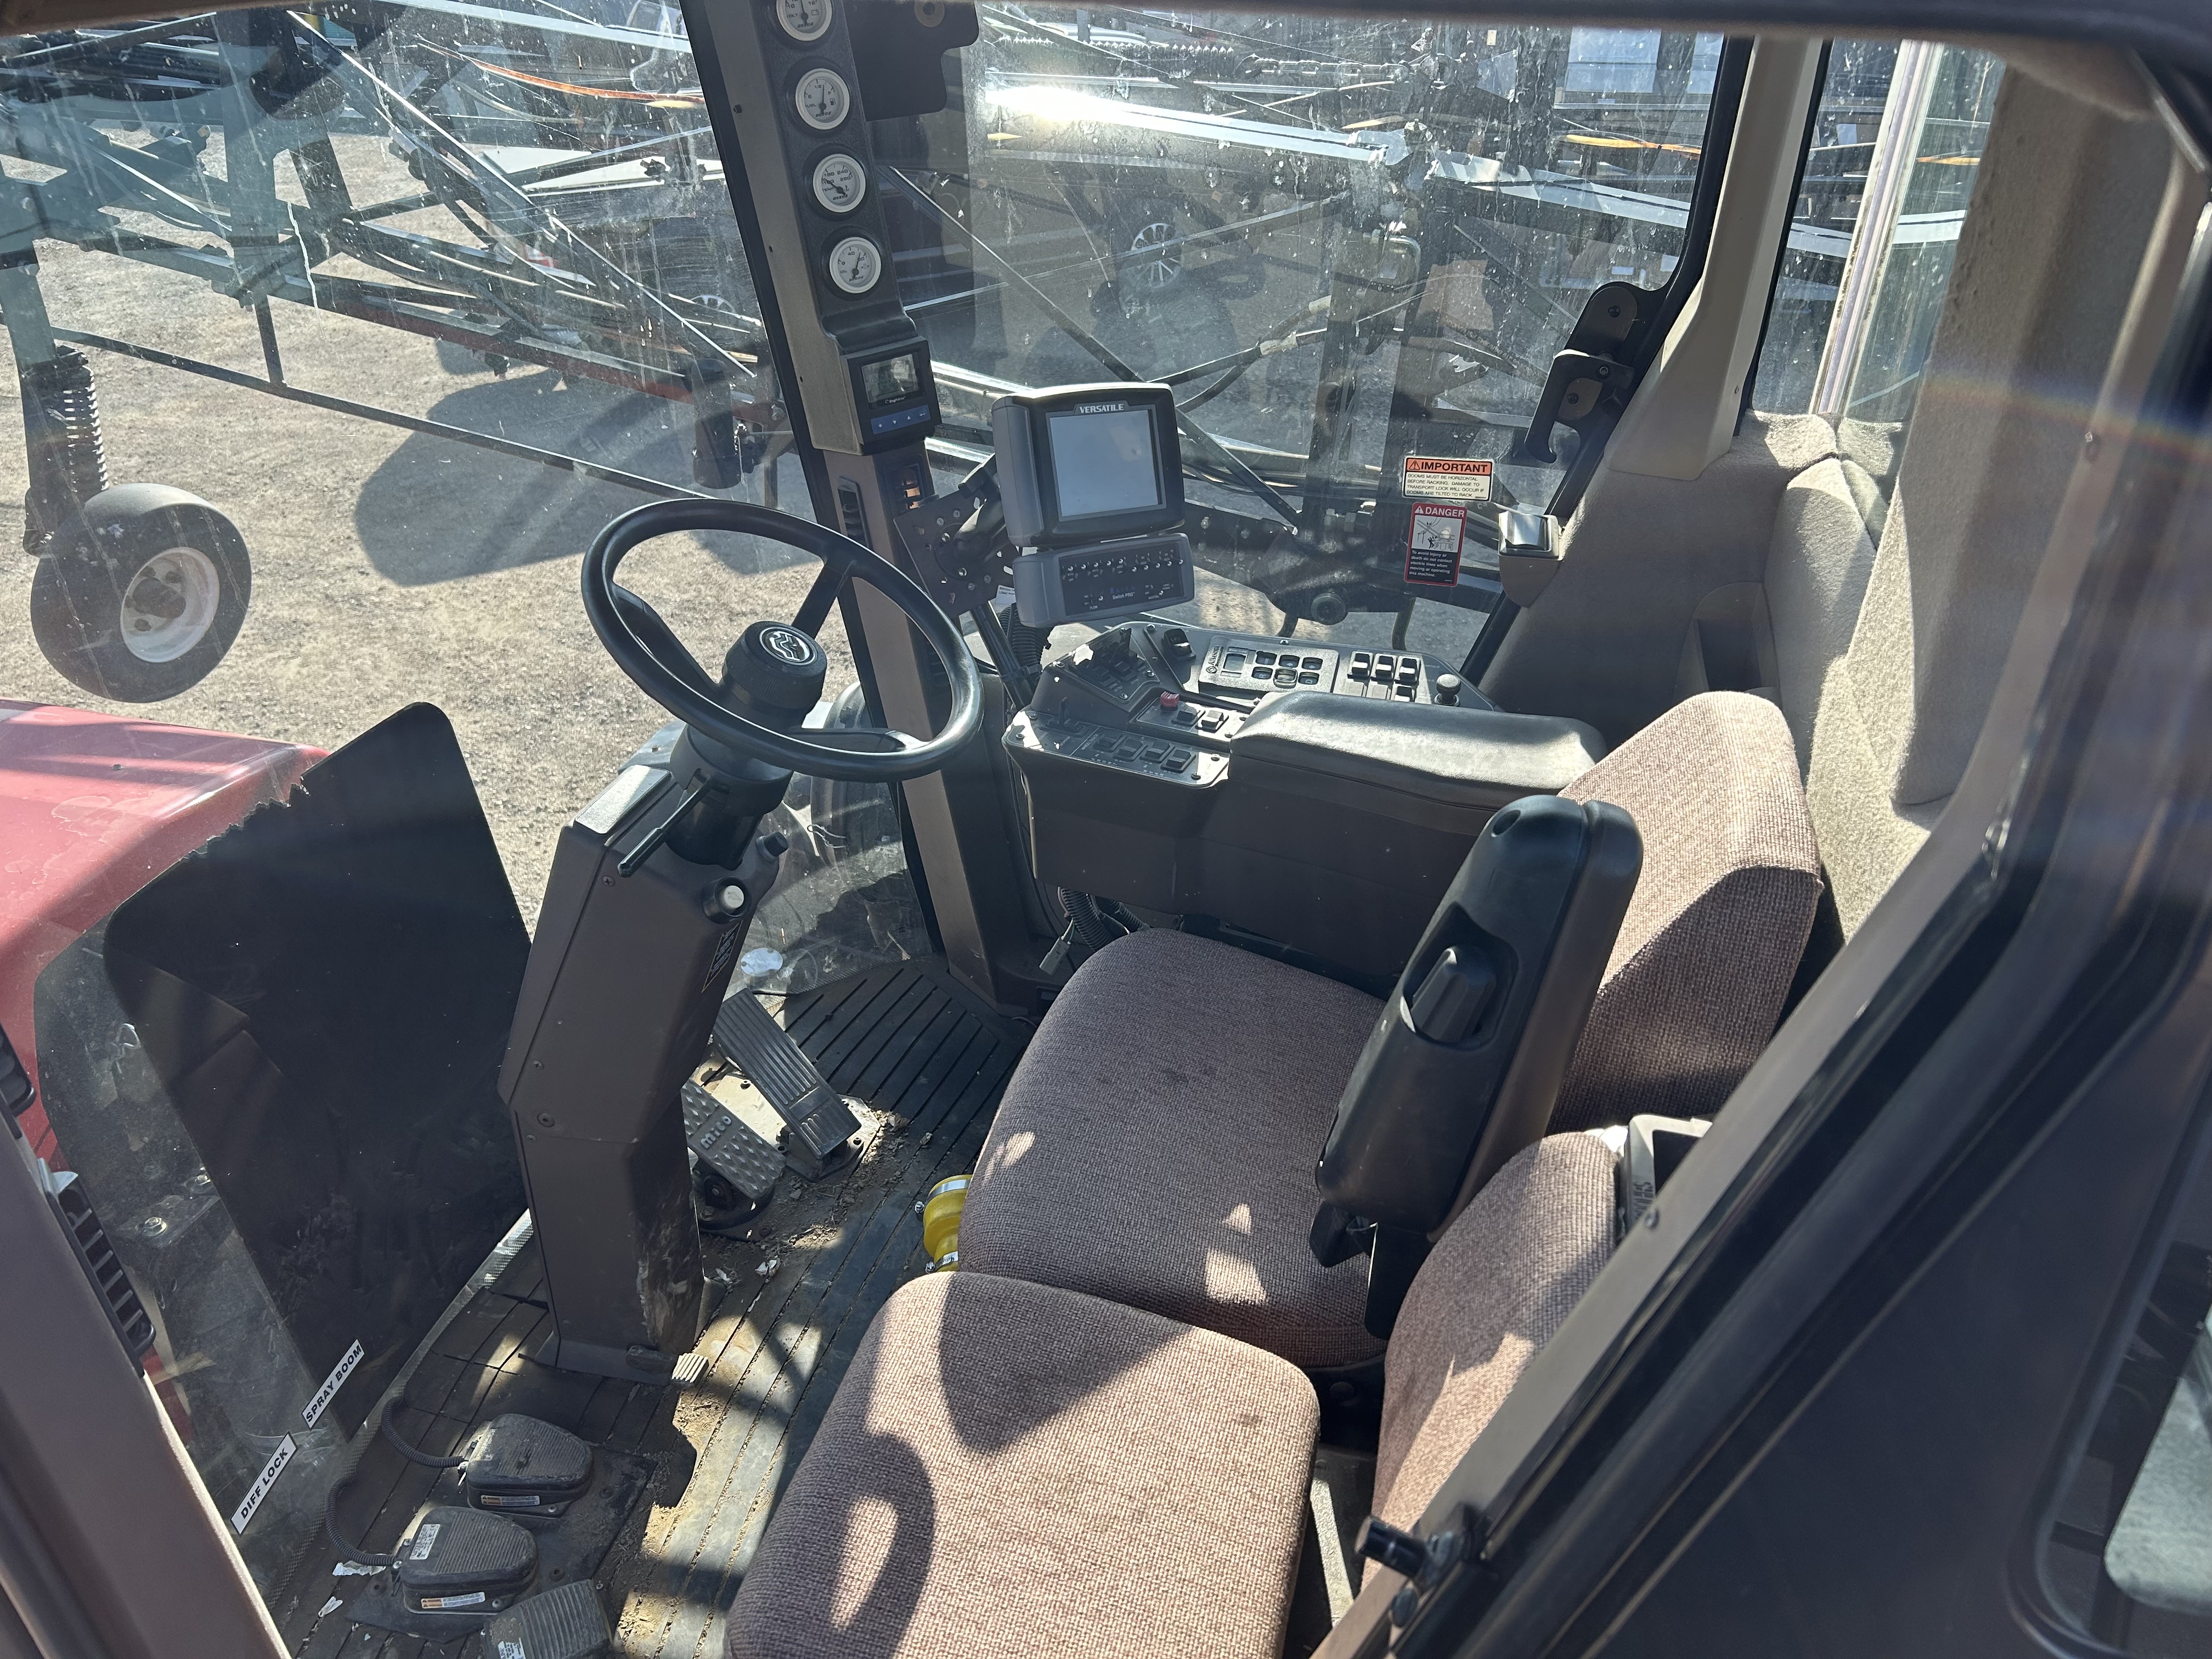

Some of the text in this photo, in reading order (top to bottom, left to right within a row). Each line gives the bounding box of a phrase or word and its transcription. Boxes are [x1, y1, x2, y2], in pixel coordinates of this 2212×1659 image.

[1079, 404, 1124, 414] VERSATILE
[1421, 462, 1488, 473] IMPORTANT
[1425, 506, 1465, 518] DANGER
[306, 1344, 362, 1423] SPRAY BOOM
[241, 1448, 289, 1519] DIFF LOCK
